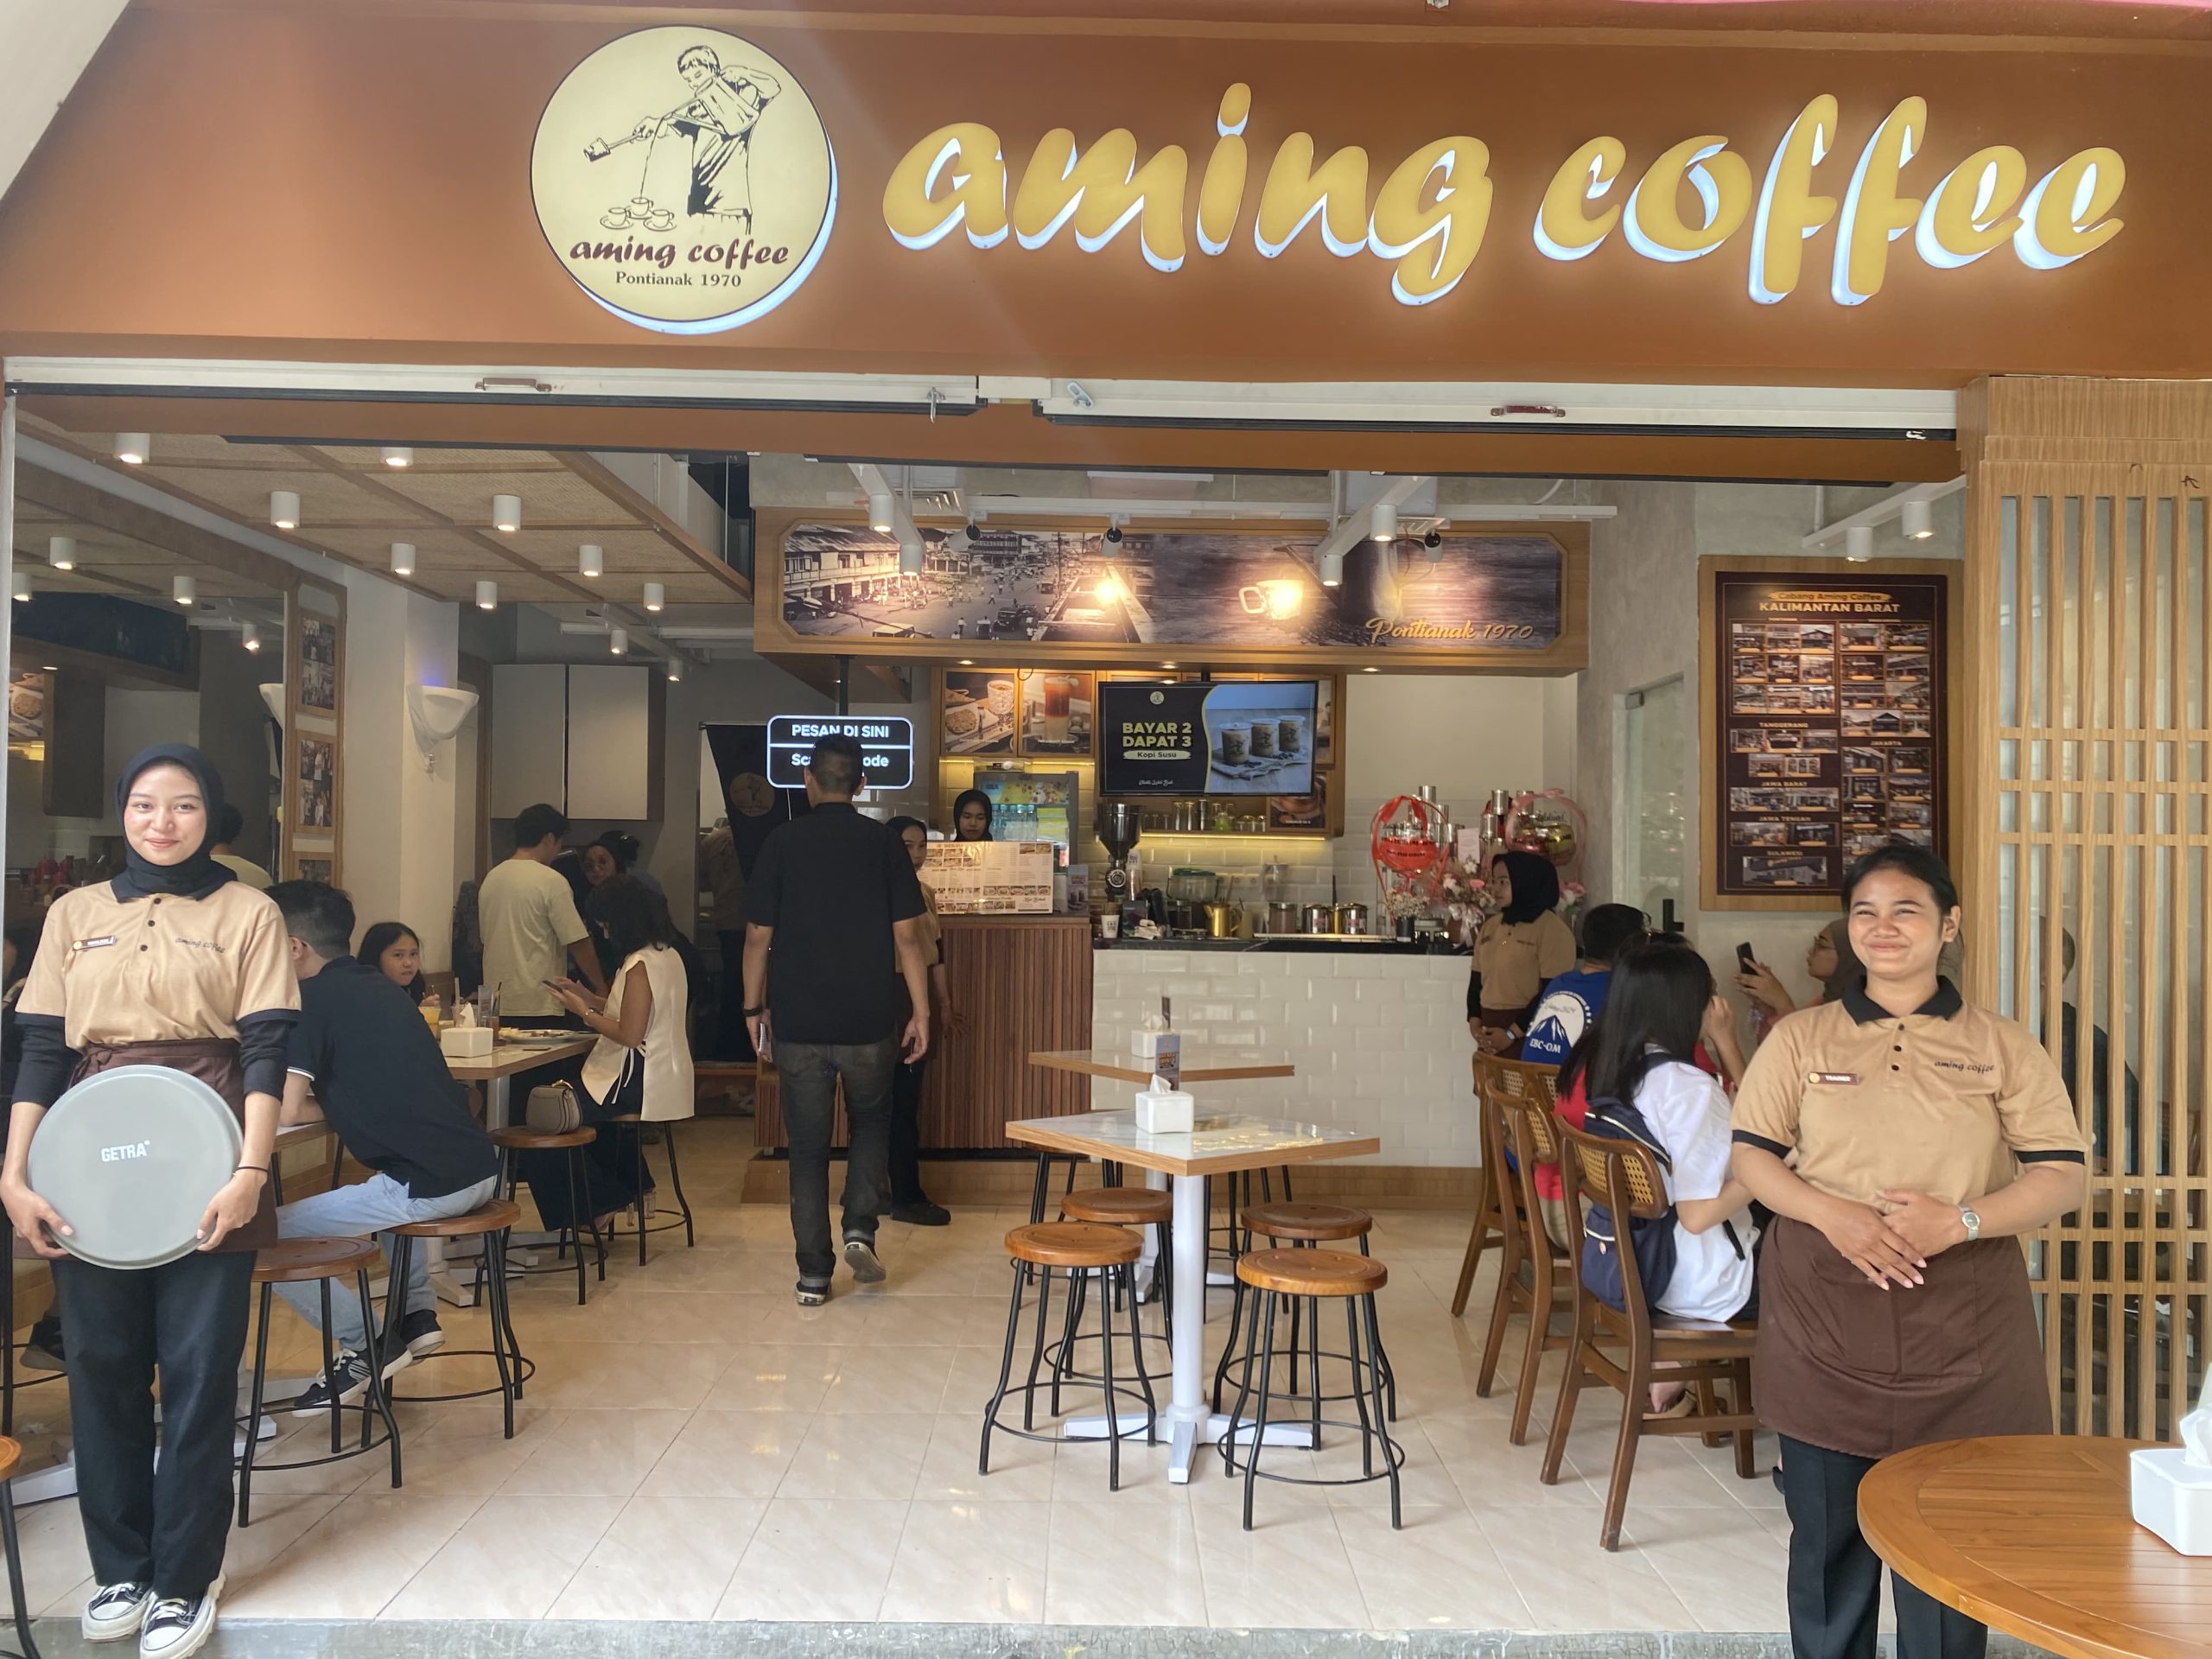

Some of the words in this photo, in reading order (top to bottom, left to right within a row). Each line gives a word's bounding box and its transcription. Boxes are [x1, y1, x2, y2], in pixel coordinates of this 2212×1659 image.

[882, 81, 1493, 305] aming
[1534, 93, 2126, 305] coffee
[569, 235, 676, 270] aming
[688, 238, 789, 270] coffee
[615, 270, 692, 286] Pontianak
[700, 273, 741, 288] 1970
[1778, 593, 1814, 601] Cabang
[1759, 602, 1850, 612] KALIMANTAN
[1853, 604, 1900, 613] BARAT
[1365, 617, 1478, 644] Pontianak
[1484, 624, 1534, 639] 1970
[791, 724, 840, 737] PESAN
[843, 725, 858, 737] DI
[861, 725, 889, 738] SINI
[1122, 722, 1176, 734] BAYAR
[1182, 722, 1192, 734] 2
[1122, 735, 1176, 747] DAPAT
[1182, 735, 1192, 747] 3
[791, 753, 810, 766] Sc
[862, 754, 889, 767] ode
[1137, 751, 1156, 760] Kopi
[1935, 1059, 1964, 1072] aming
[101, 1141, 148, 1162] GETRA
